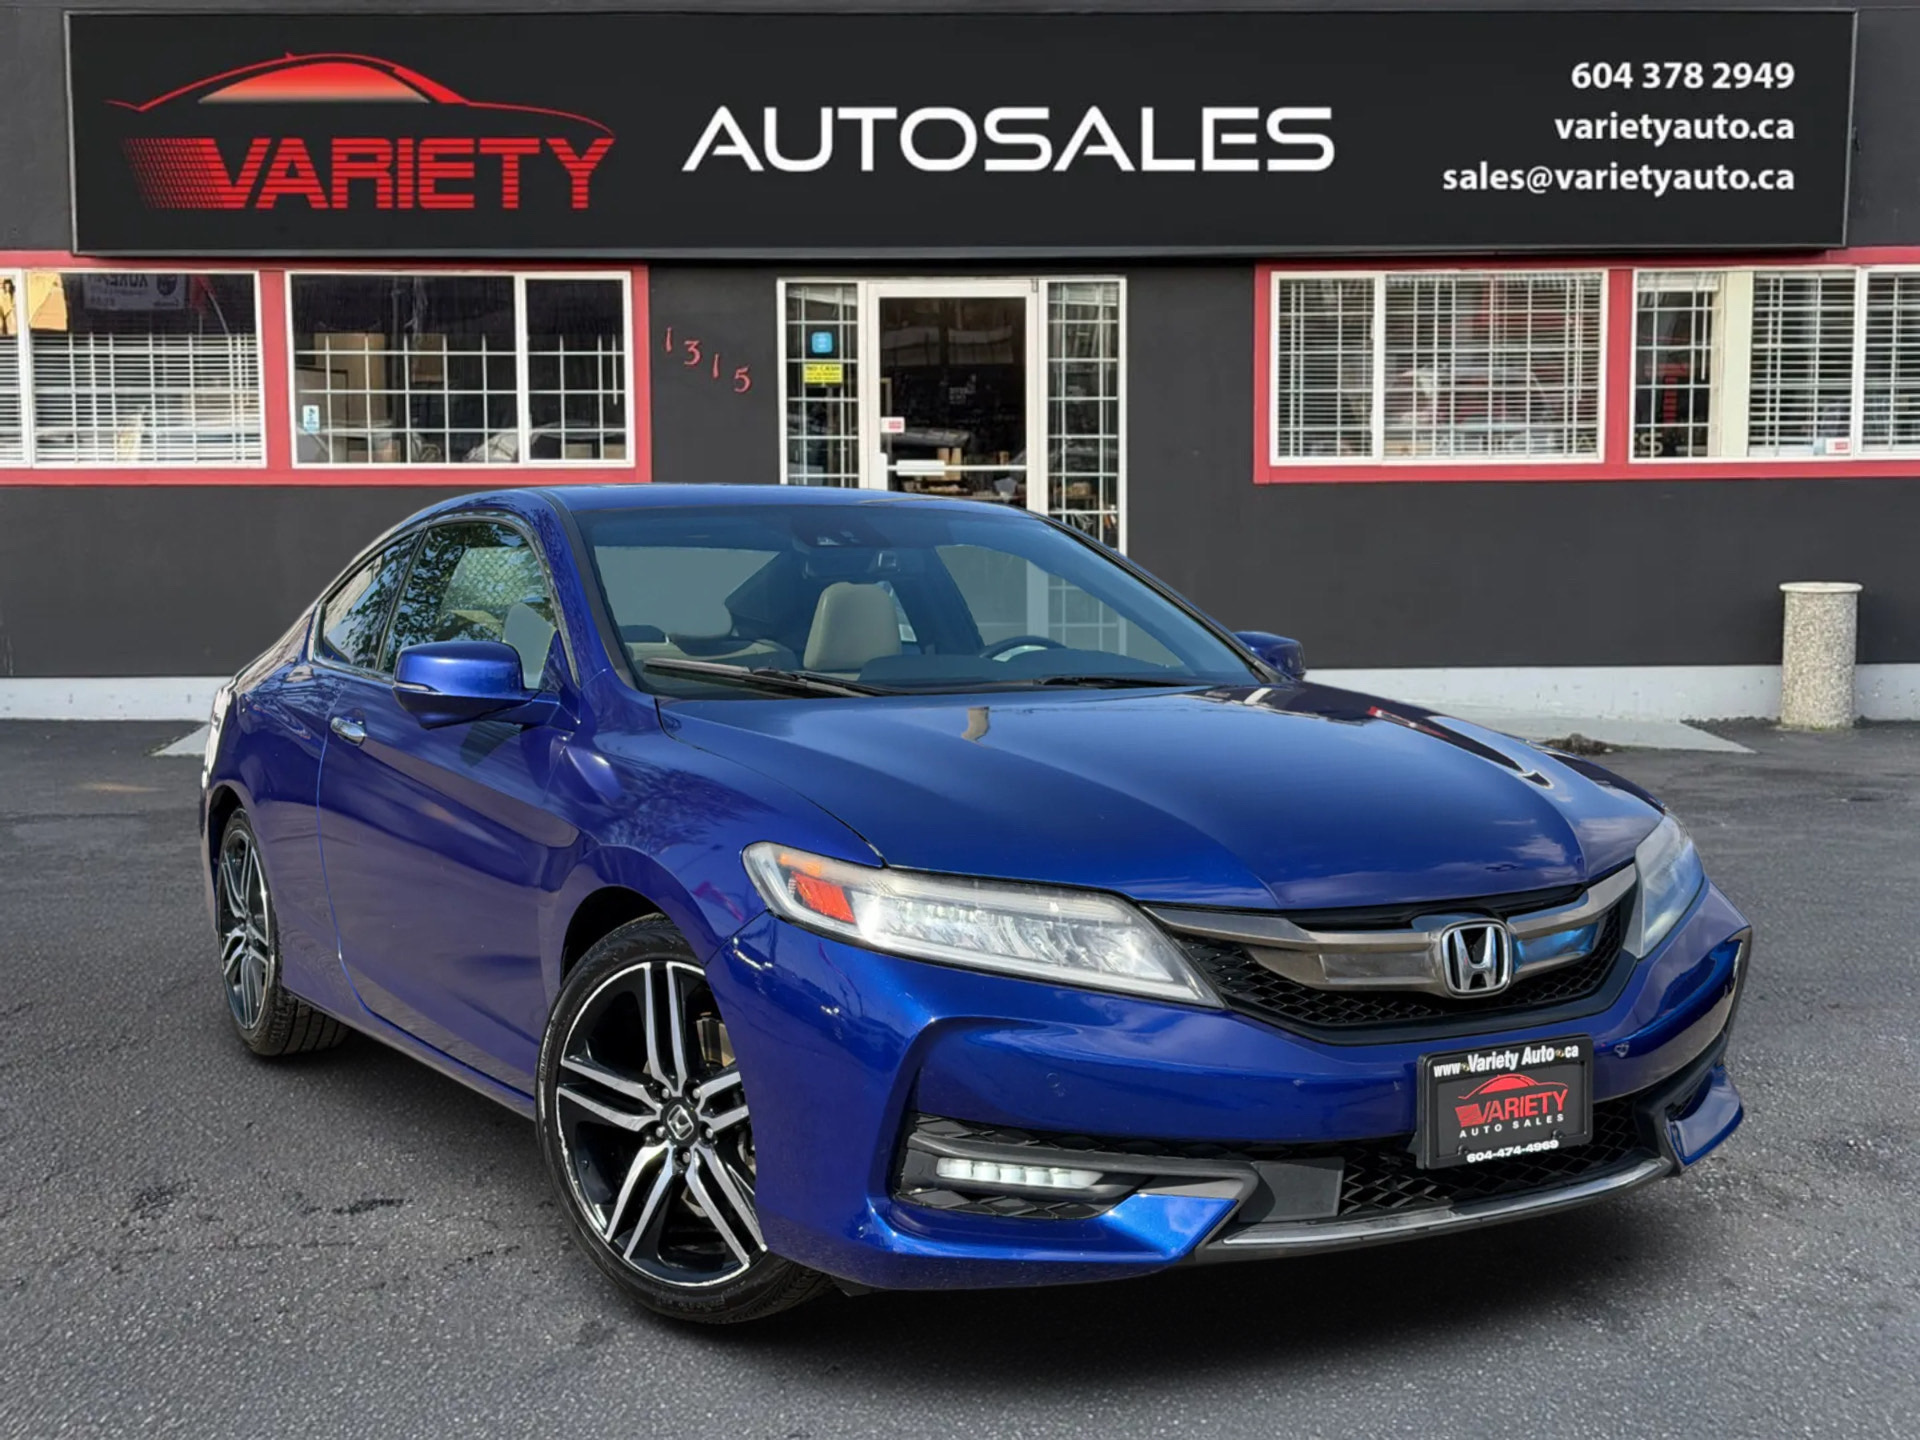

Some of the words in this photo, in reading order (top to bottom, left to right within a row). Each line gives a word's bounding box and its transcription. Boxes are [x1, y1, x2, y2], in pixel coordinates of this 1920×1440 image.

[1571, 61, 1634, 89] 604
[1642, 61, 1704, 89] 378
[1711, 61, 1795, 89] 2949
[681, 105, 1335, 172] AUTOSALES
[1554, 110, 1795, 147] varietyauto.ca
[130, 136, 615, 210] VARIETY
[1443, 160, 1795, 198] sales@varietyauto.ca
[1455, 1088, 1568, 1127] VARIETY
[1459, 1123, 1502, 1138] AUTO
[1512, 1113, 1564, 1129] SALES
